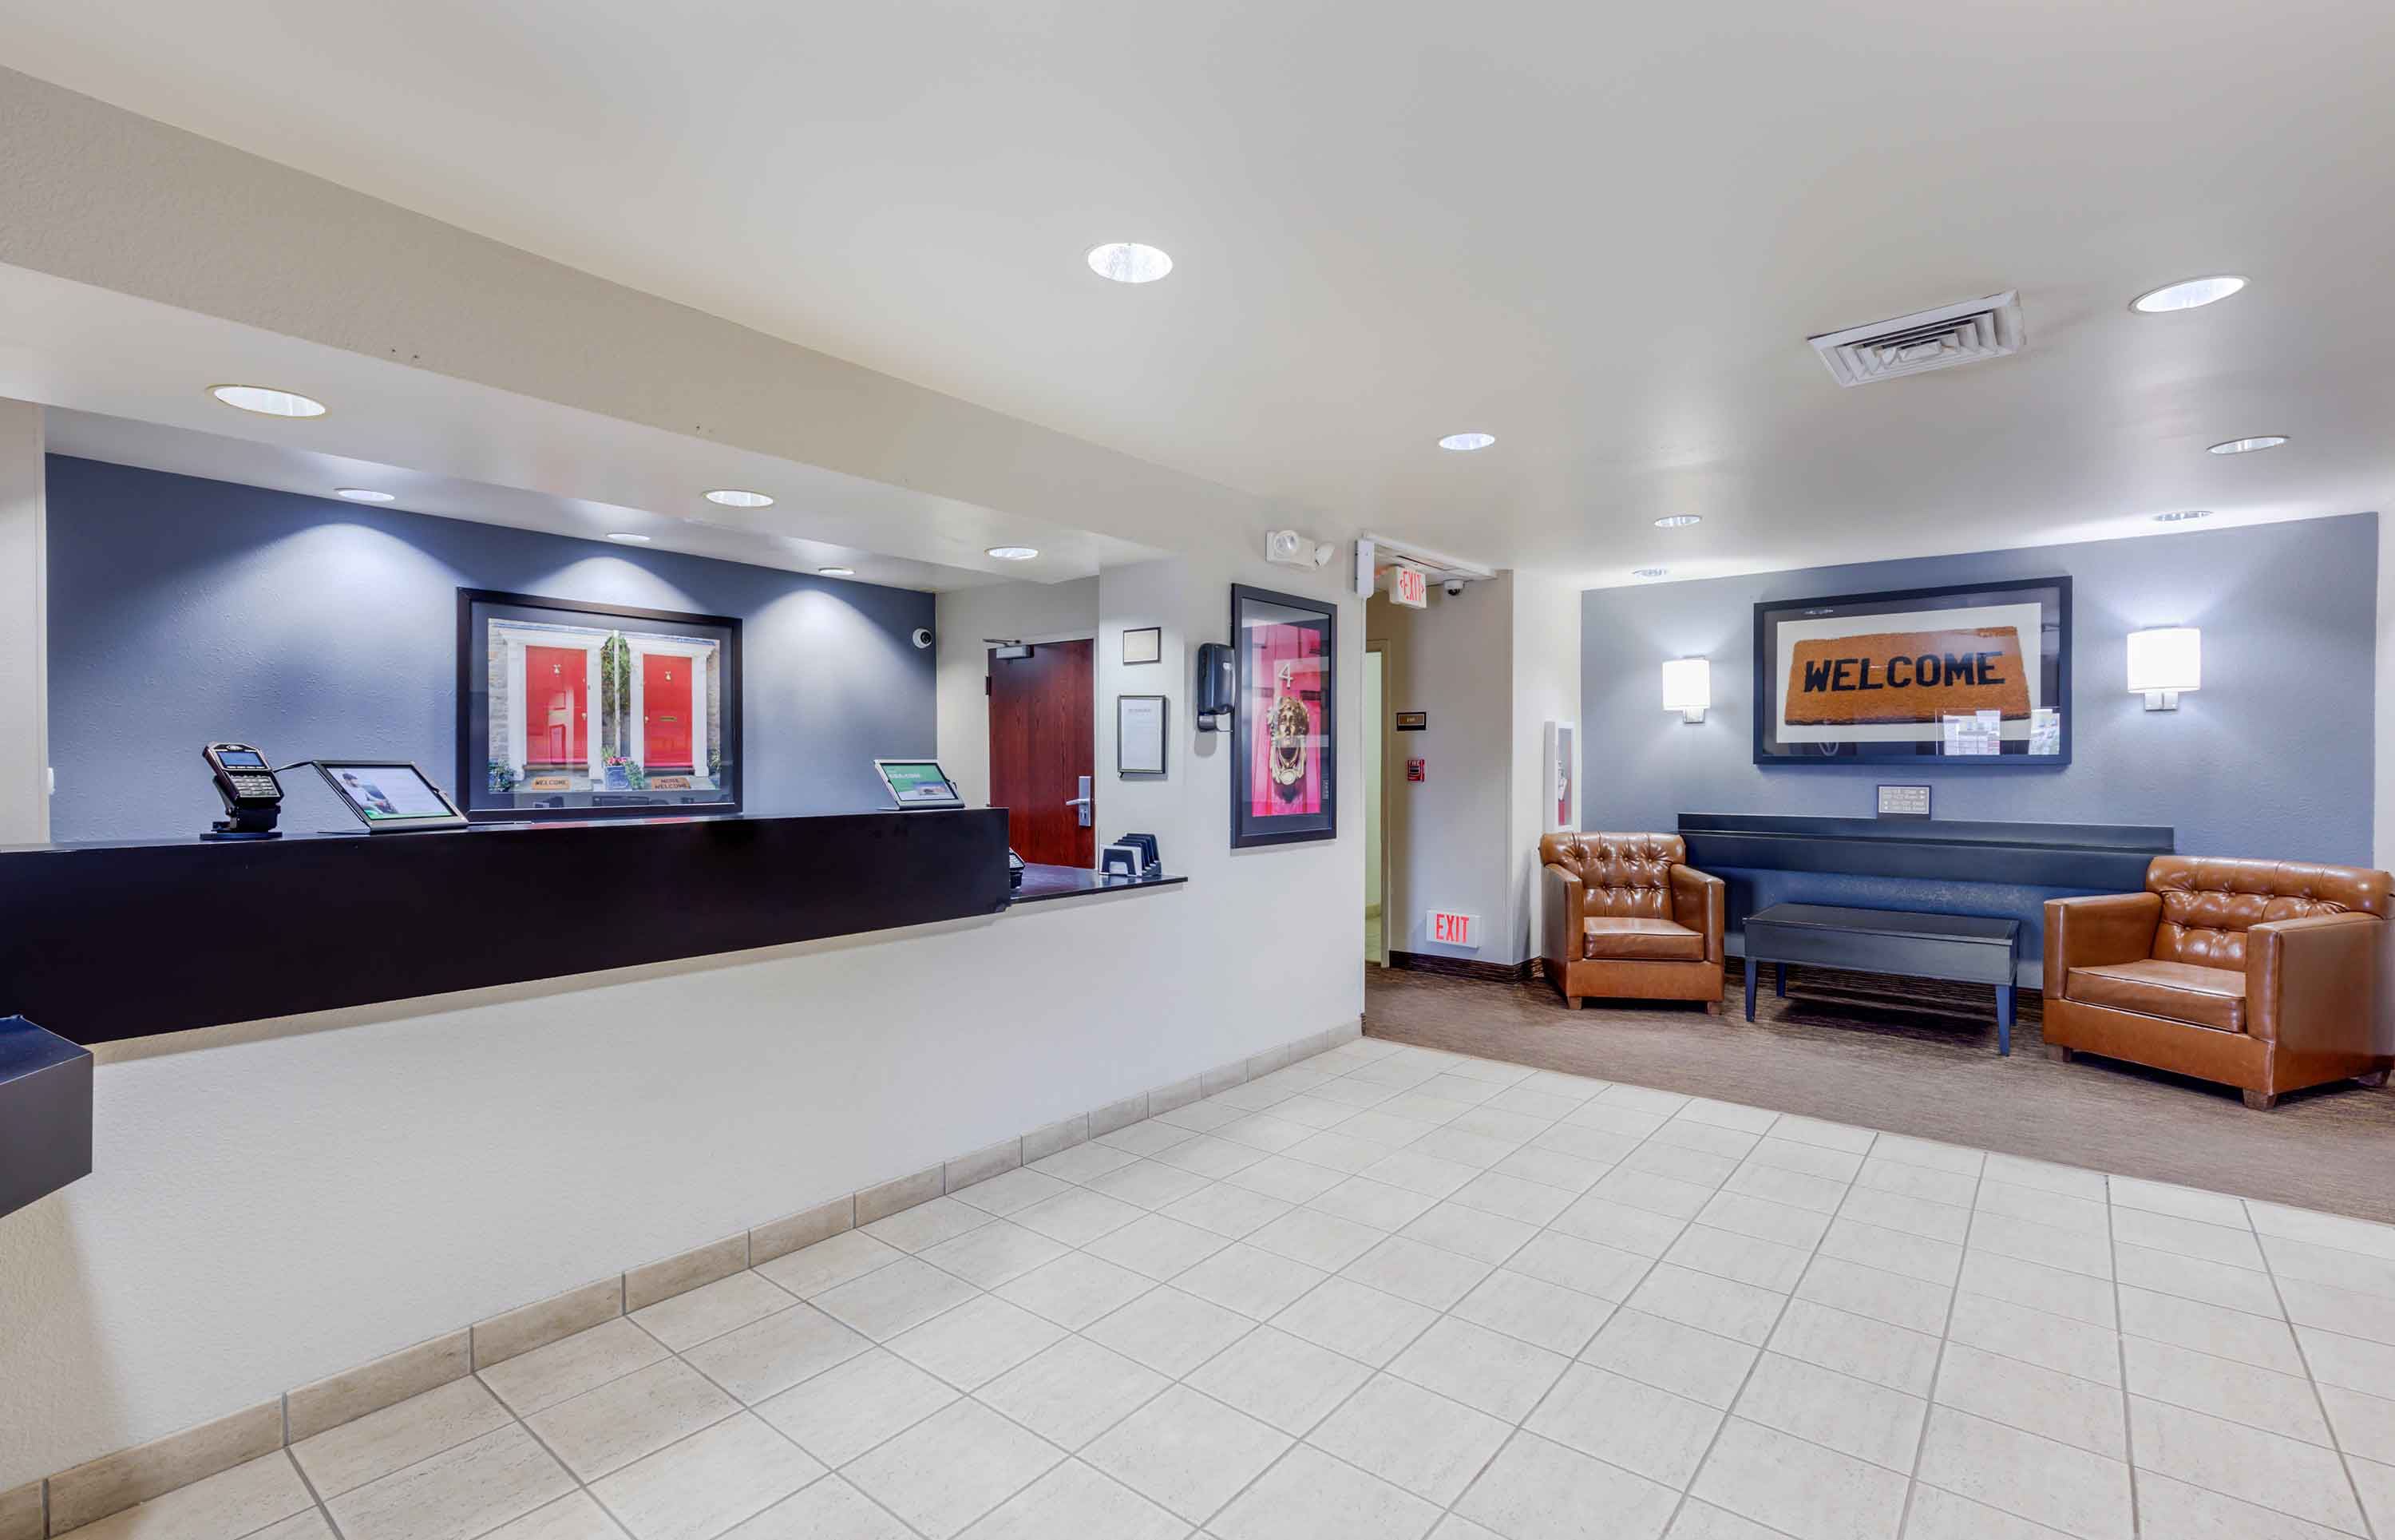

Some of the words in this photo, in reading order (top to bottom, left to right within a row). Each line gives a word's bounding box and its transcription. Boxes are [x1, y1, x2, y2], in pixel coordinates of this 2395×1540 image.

[1403, 570, 1422, 600] EXIT
[1278, 663, 1295, 688] 4
[1803, 651, 2006, 693] WELCOME
[1436, 913, 1470, 944] EXIT
